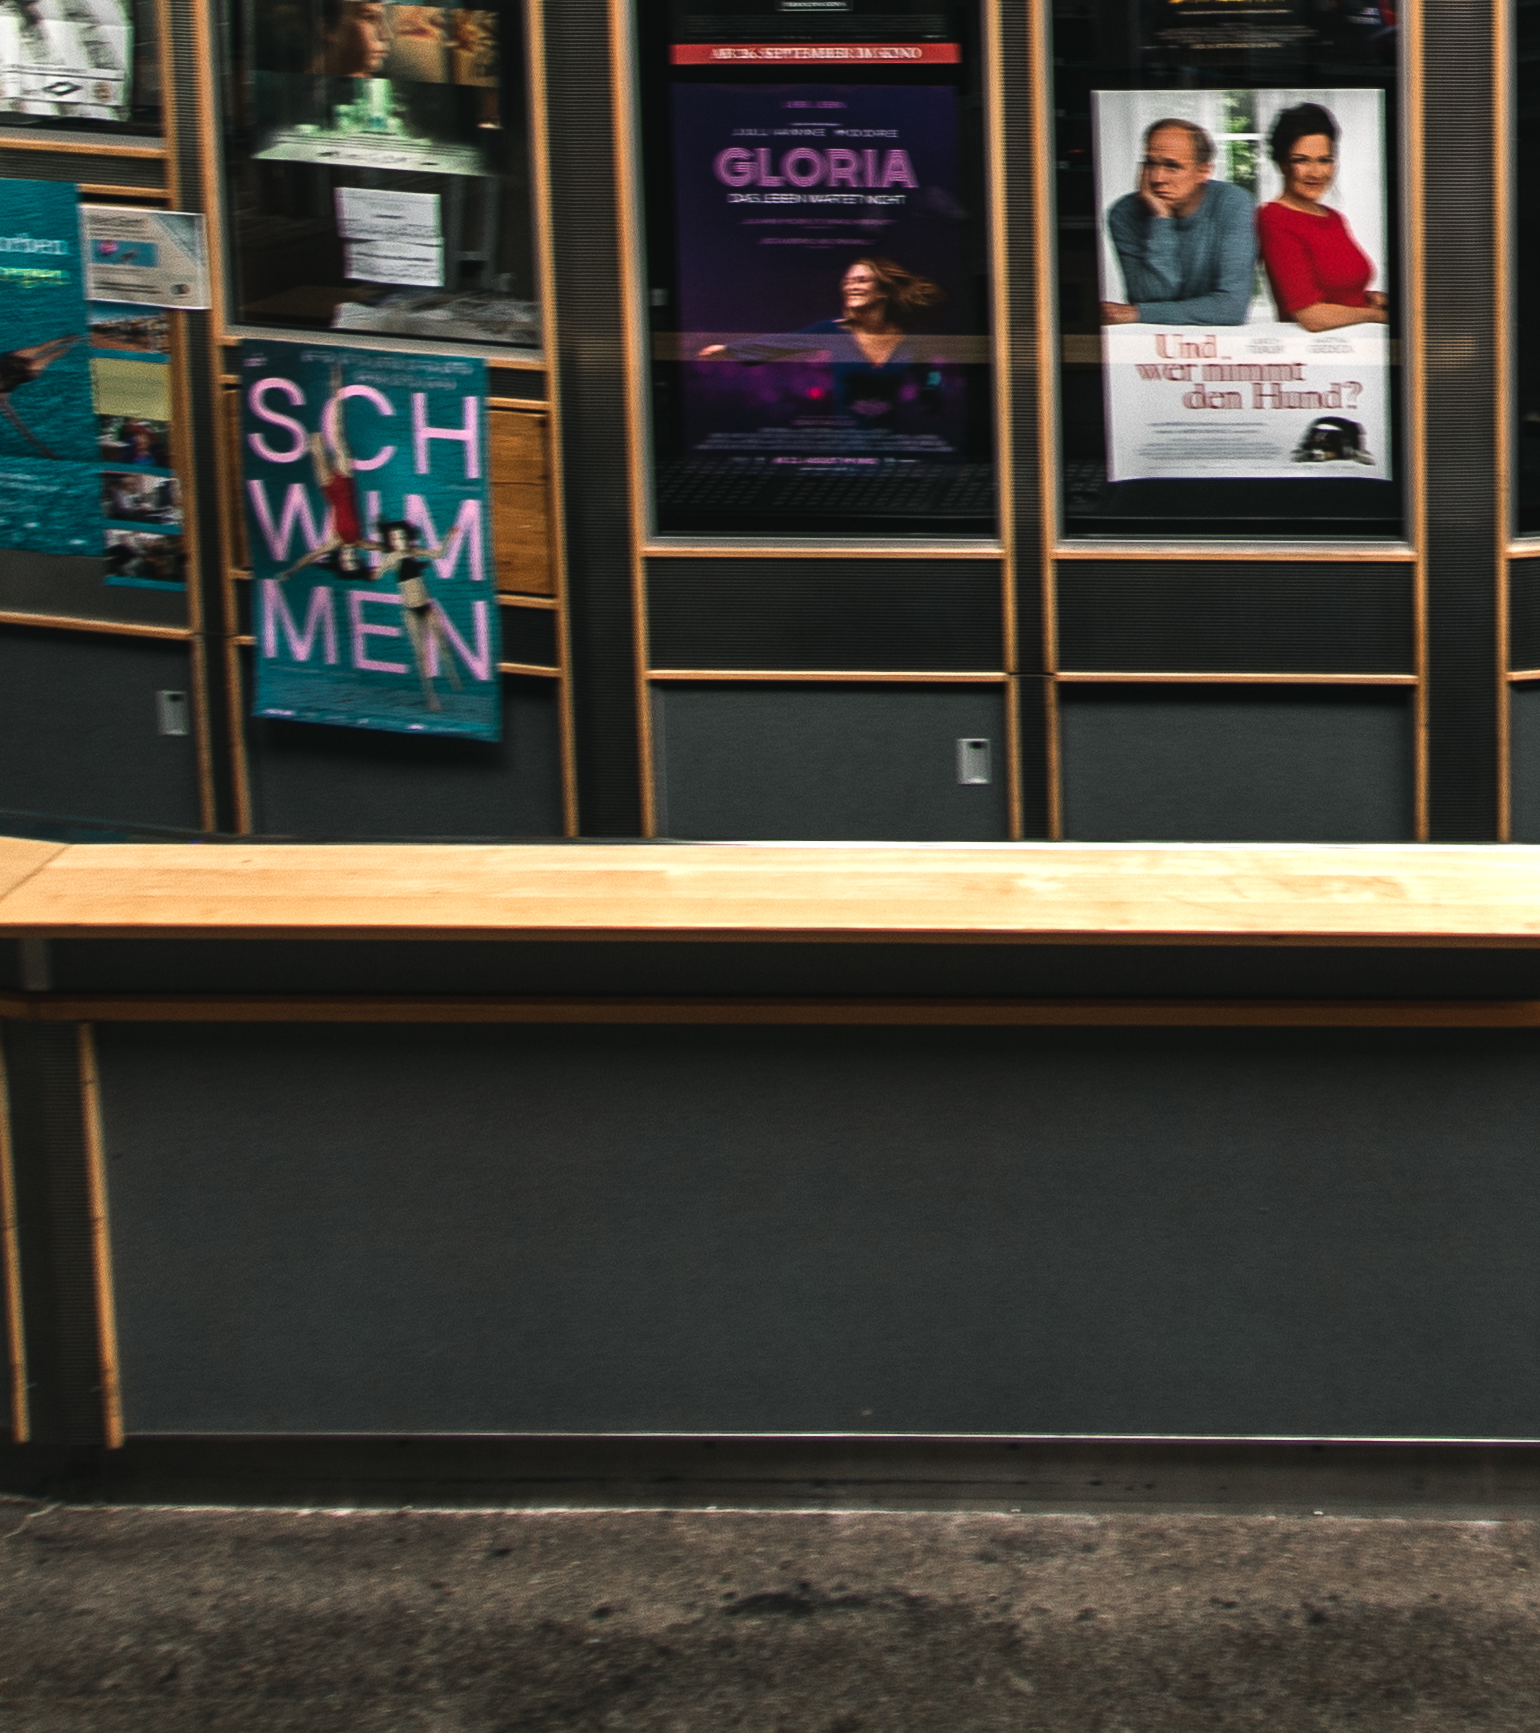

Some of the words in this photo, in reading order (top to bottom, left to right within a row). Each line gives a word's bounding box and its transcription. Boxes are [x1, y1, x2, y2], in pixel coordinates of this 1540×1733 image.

[765, 47, 855, 61] SEPTEMBER
[876, 47, 923, 60] KINO
[713, 146, 921, 189] GLORIA
[1134, 363, 1196, 382] wer
[1200, 362, 1307, 382] nimmt
[1181, 381, 1243, 410] den
[1250, 379, 1364, 410] Hund?
[246, 377, 482, 481] SCH
[246, 479, 486, 582] WIM
[262, 578, 493, 682] MEN
